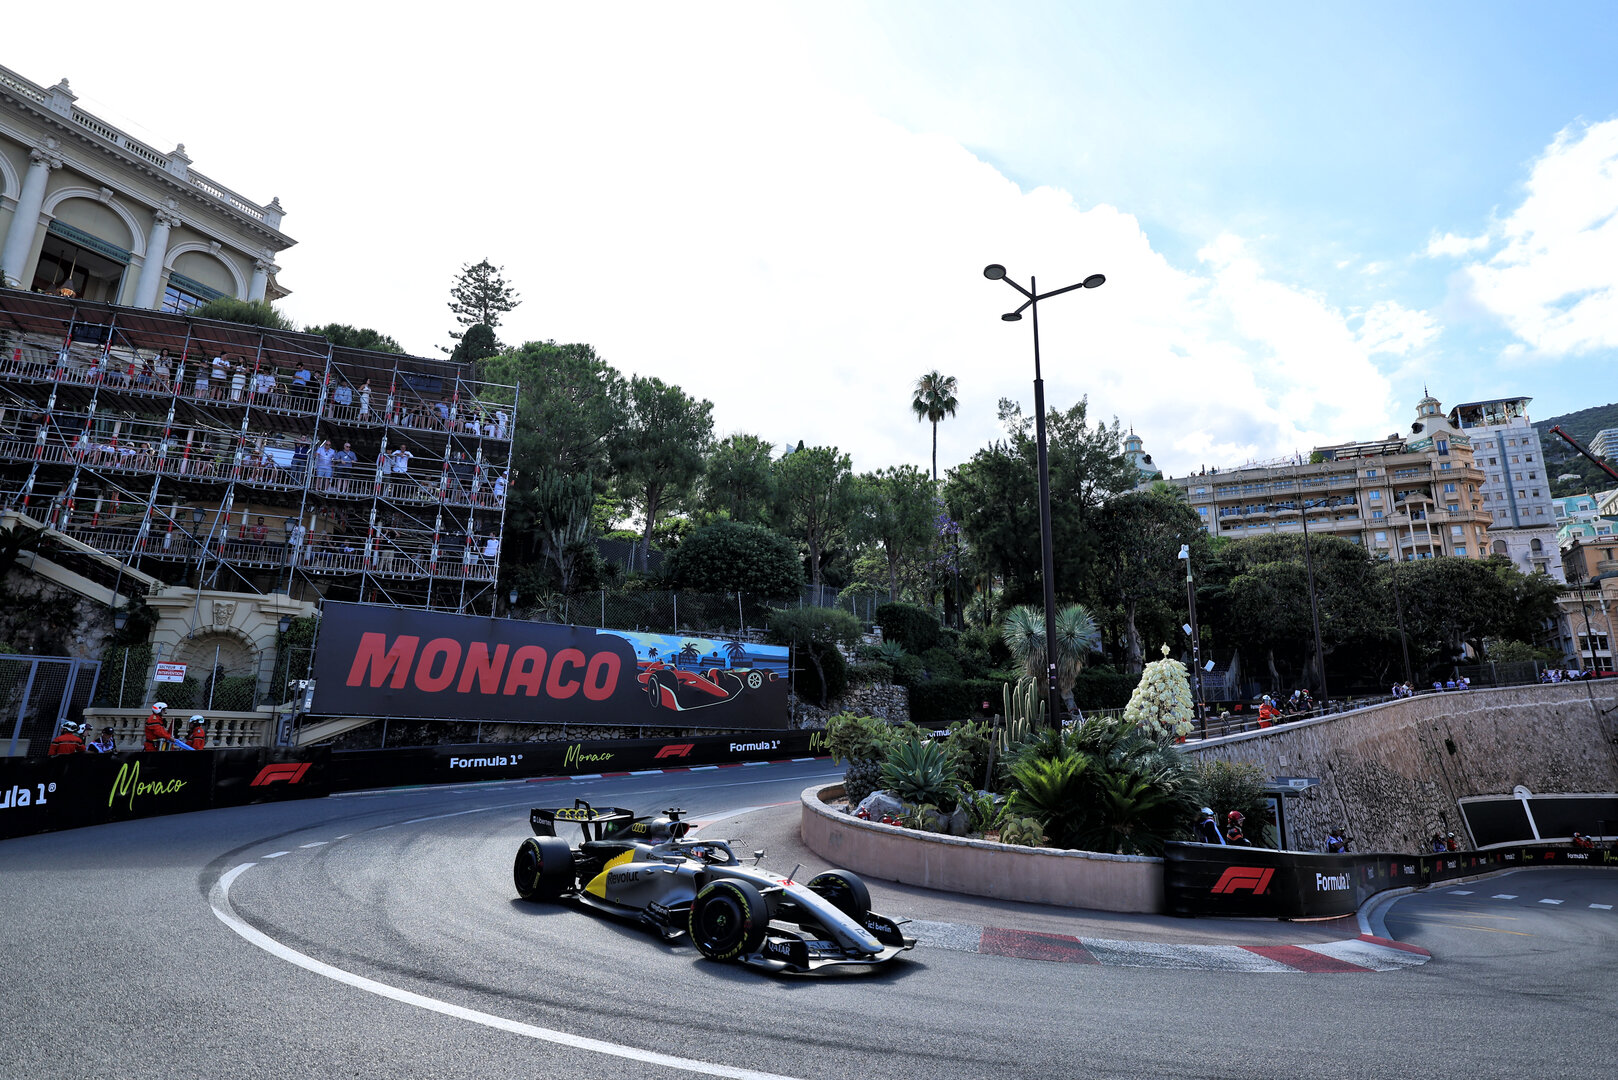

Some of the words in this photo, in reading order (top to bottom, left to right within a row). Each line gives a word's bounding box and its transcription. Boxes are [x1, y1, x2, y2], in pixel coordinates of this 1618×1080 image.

[346, 631, 621, 701] MONACO
[563, 743, 614, 769] Monaco
[729, 741, 770, 752] Formula
[449, 756, 507, 769] Formula
[108, 760, 187, 811] Monaco
[1315, 873, 1345, 891] Formula
